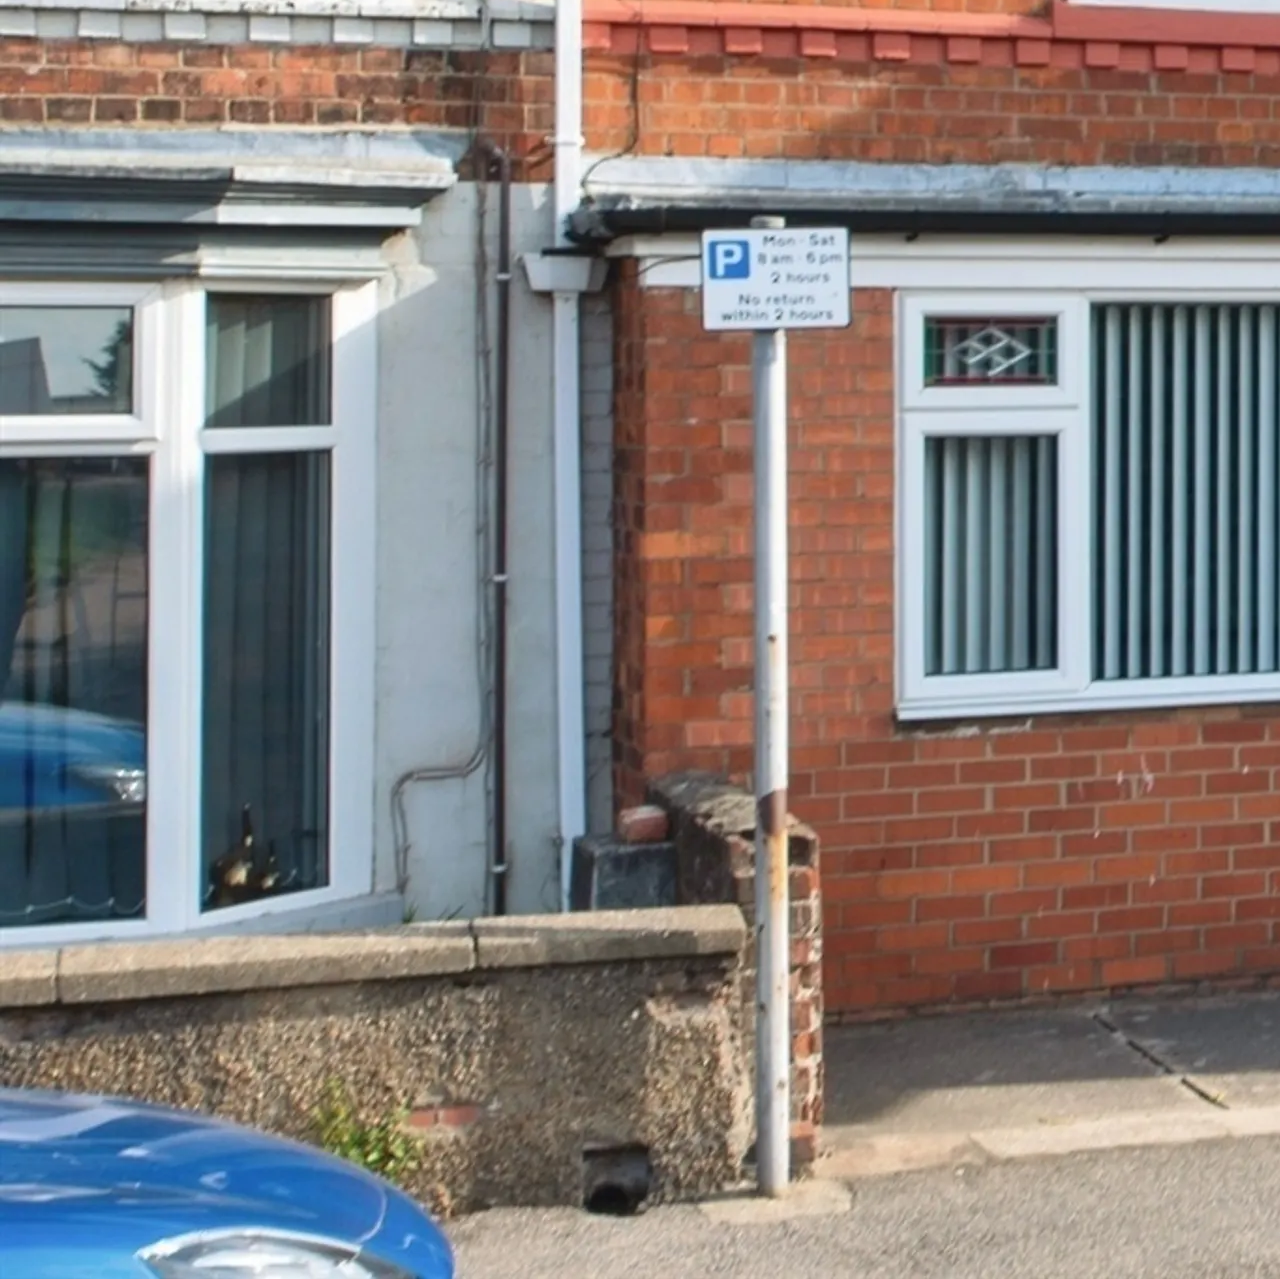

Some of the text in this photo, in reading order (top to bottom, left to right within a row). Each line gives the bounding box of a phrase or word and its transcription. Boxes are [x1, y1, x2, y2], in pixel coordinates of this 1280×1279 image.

[762, 235, 796, 247] Mon
[808, 233, 836, 247] Sat
[715, 244, 743, 278] P
[770, 272, 830, 284] 2 hours
[738, 294, 815, 306] No return
[720, 308, 834, 321] within 2 hours
